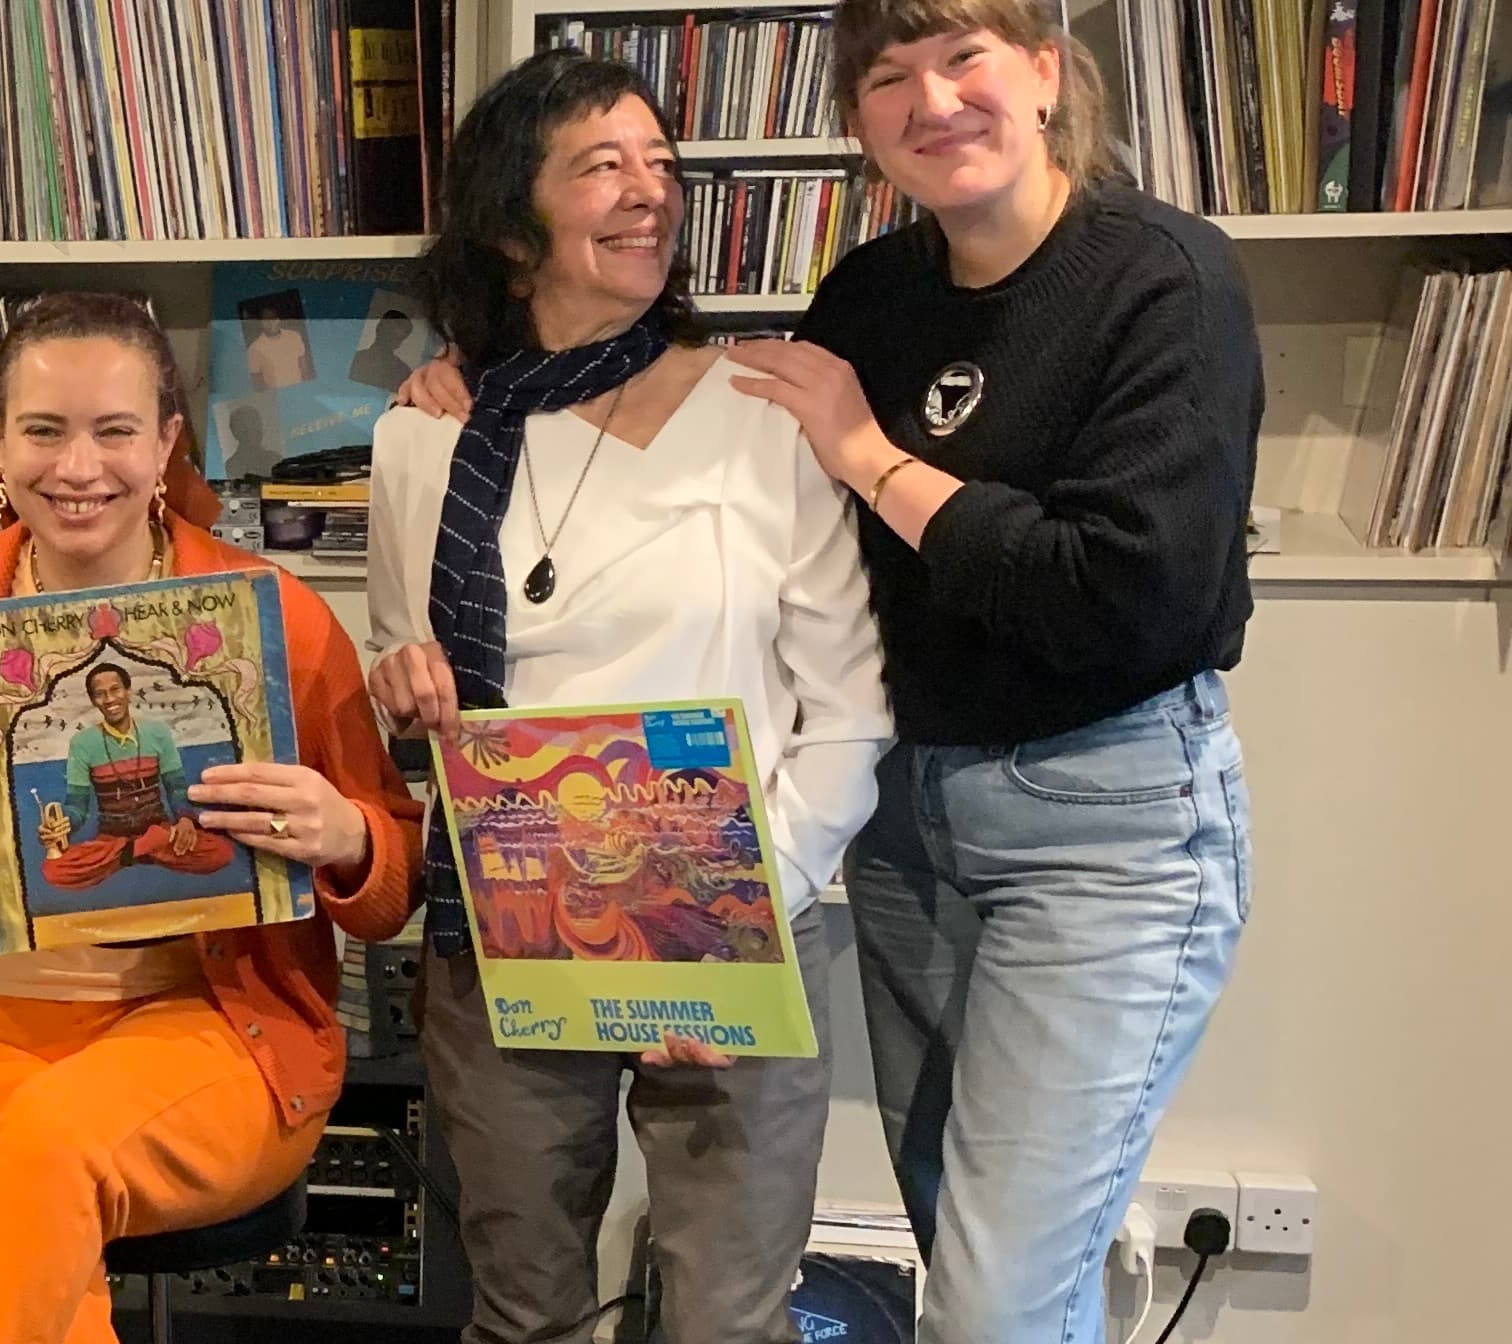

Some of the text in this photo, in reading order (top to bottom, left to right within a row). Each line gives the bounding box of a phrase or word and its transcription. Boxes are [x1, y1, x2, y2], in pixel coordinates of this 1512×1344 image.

[124, 593, 236, 623] HEAR & NOW
[22, 614, 85, 636] CHERRY
[495, 998, 567, 1041] Don Cherry
[590, 999, 715, 1022] THE SUMMER
[595, 1022, 661, 1044] HOUSE
[815, 1325, 848, 1341] FORCE
